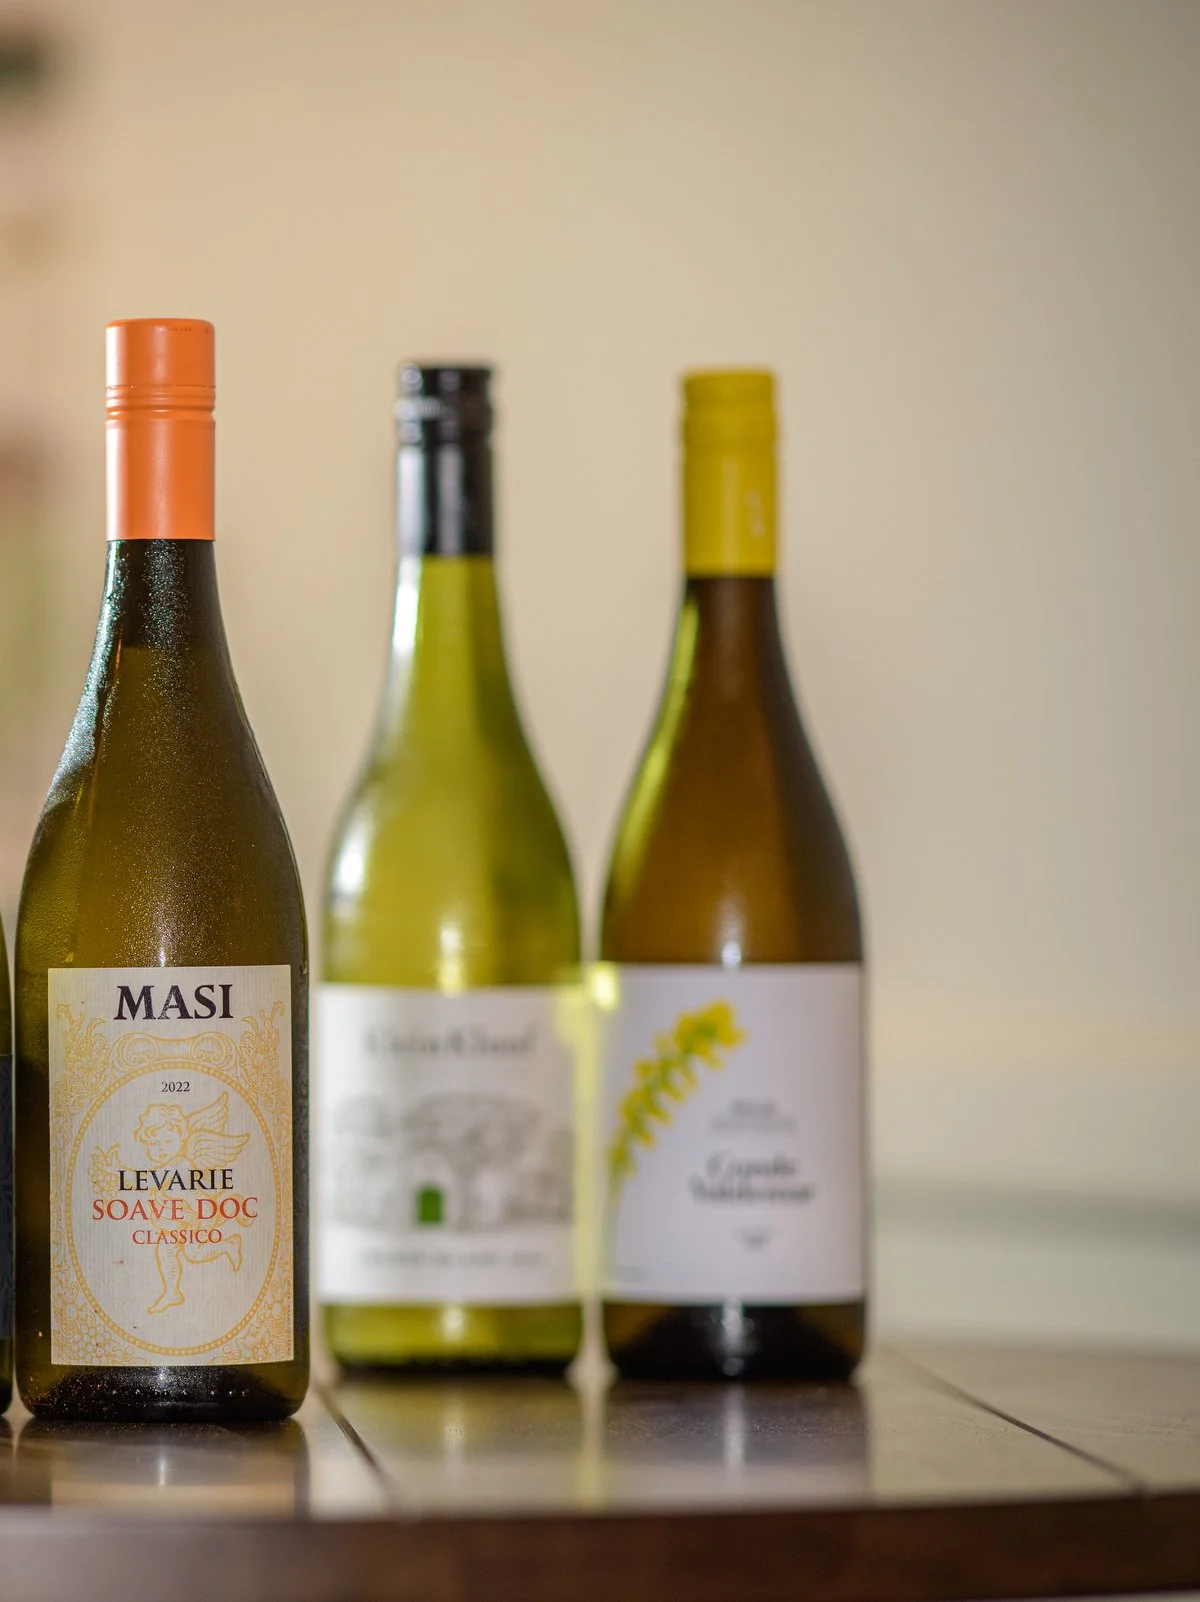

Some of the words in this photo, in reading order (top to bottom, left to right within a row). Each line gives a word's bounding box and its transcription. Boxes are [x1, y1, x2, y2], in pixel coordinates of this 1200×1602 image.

[114, 984, 234, 1021] MASI
[161, 1081, 191, 1093] 2022
[118, 1169, 234, 1191] LEVARIE
[92, 1199, 185, 1221] SOAVE
[196, 1197, 258, 1220] DOC
[132, 1228, 222, 1245] CLASSICO
